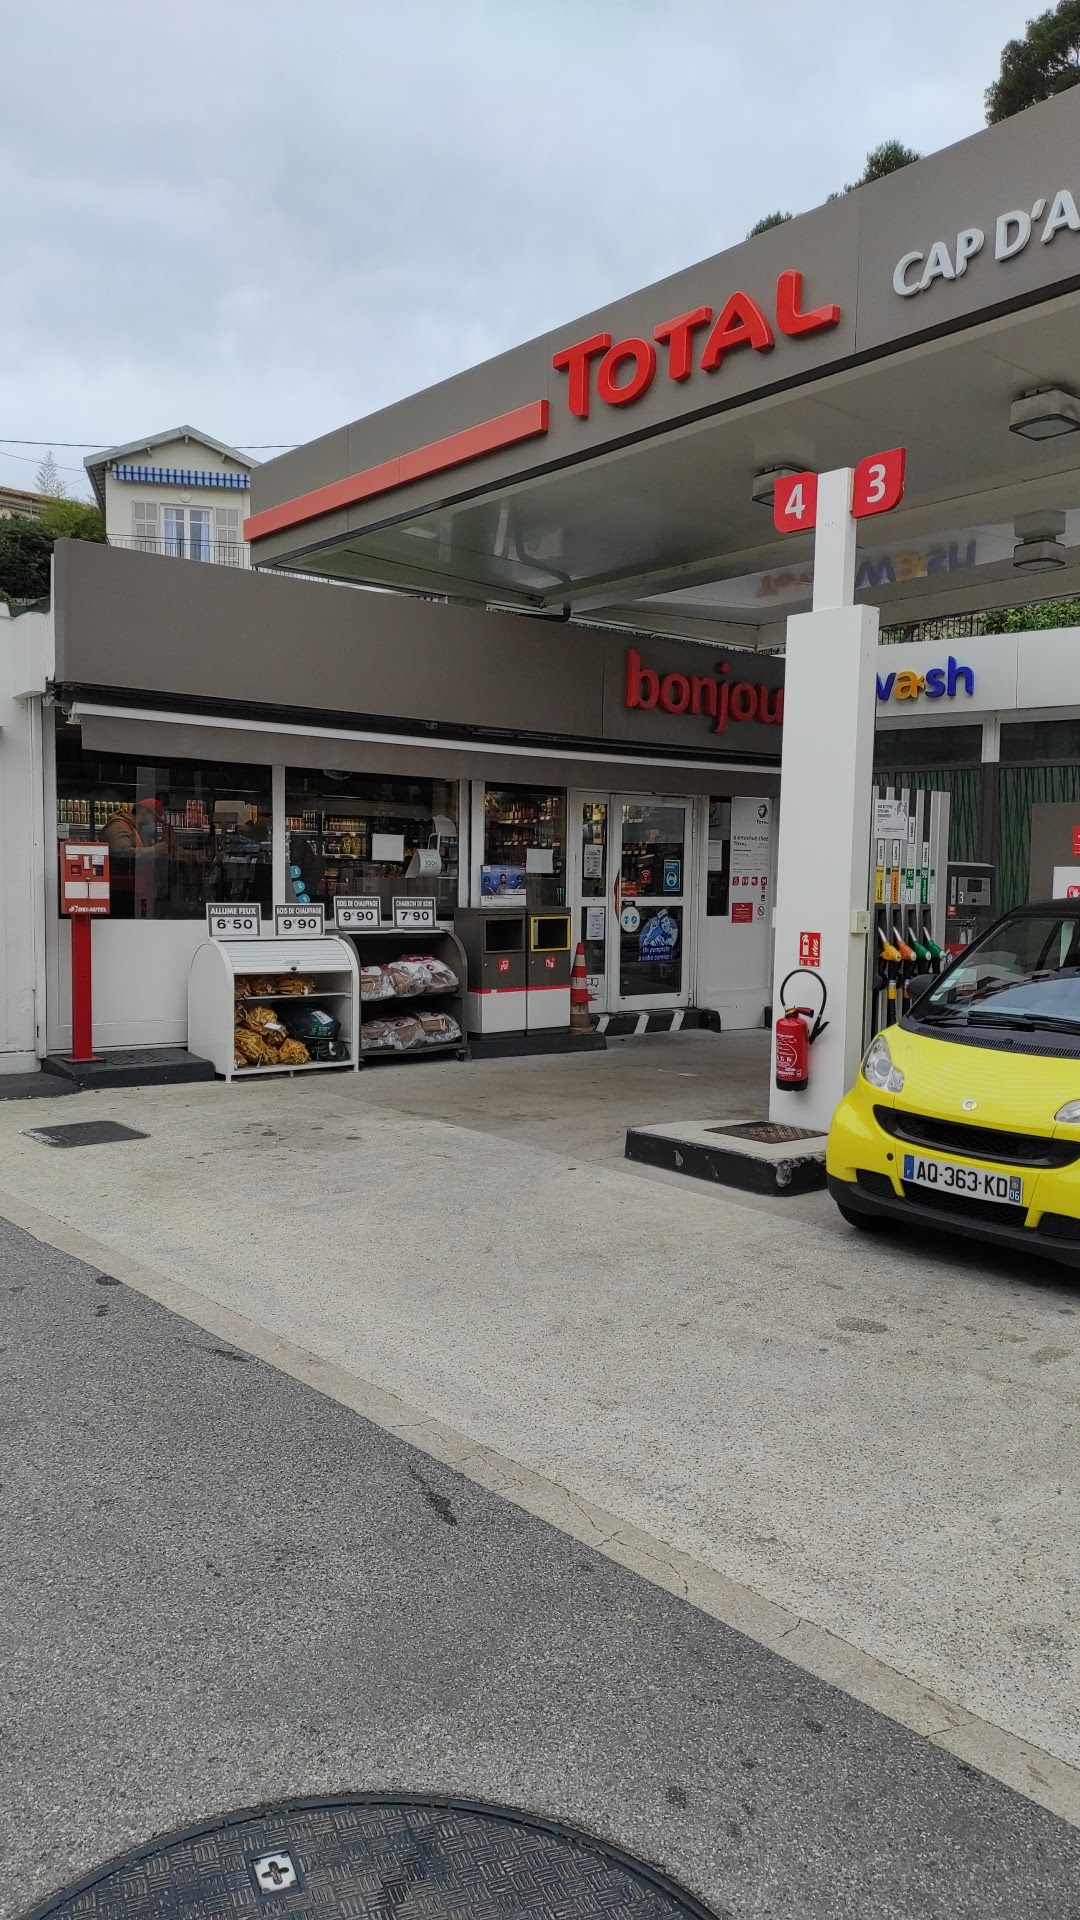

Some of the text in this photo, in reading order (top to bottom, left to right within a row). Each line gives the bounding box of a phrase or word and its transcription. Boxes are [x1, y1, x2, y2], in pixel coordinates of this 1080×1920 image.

[893, 241, 985, 296] CAP
[552, 269, 841, 419] TOTAL
[784, 483, 806, 520] 4
[866, 463, 886, 503] 3
[625, 648, 785, 734] bonjou
[210, 907, 257, 915] ALLUME FEUX
[276, 907, 322, 915] BOIS DE CHAUFFAGE
[959, 891, 965, 904] 3
[1009, 1189, 1020, 1201] 06
